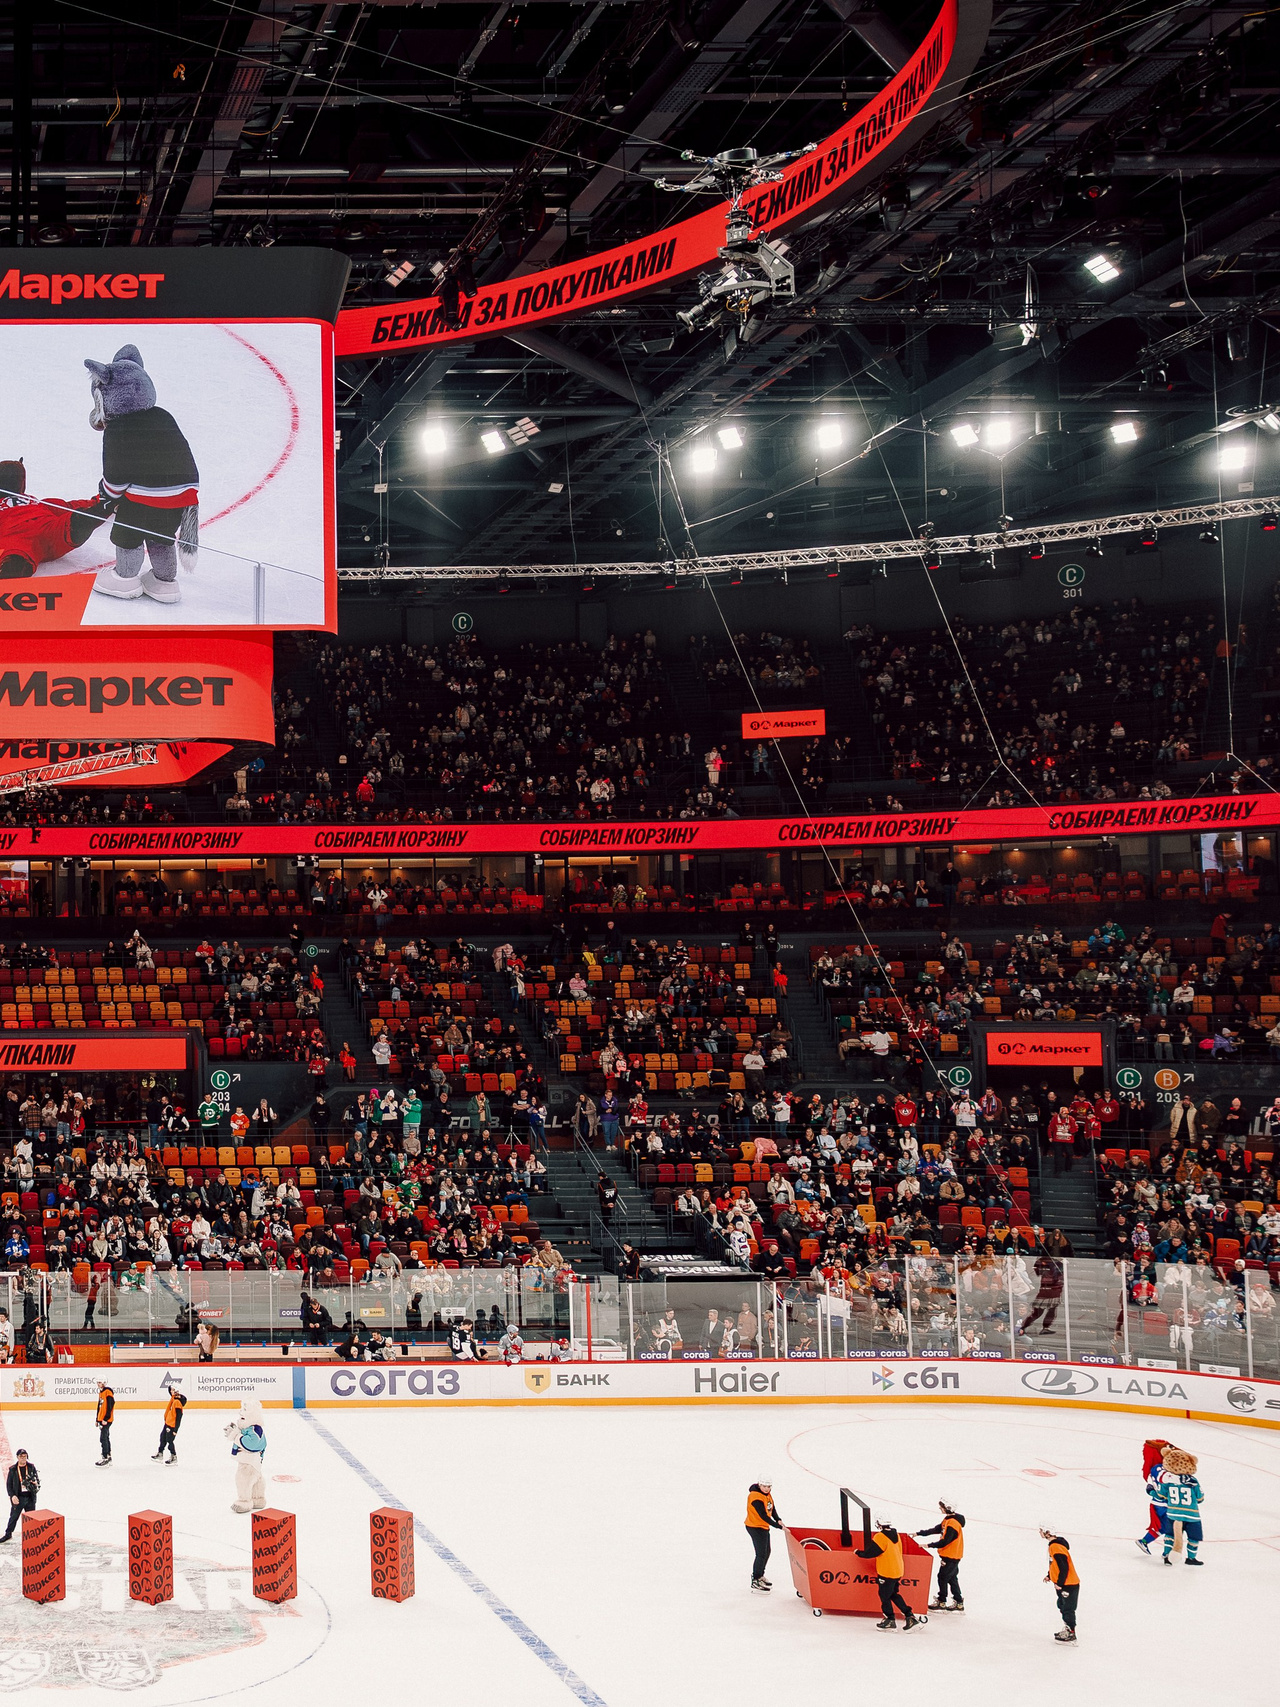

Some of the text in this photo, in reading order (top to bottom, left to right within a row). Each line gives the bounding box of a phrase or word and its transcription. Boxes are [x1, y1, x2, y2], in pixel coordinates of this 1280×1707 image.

[824, 134, 852, 186] ЗА
[852, 25, 945, 164] ПОКУПКАМИ
[474, 295, 511, 327] ЗА
[510, 237, 677, 320] ПОКУПКАМИ
[1063, 588, 1082, 598] 301
[772, 720, 817, 729] Маркет
[1048, 800, 1259, 830] СОБИРАЕМ КОРЗИНУ
[314, 829, 468, 848] СОБИРАЕМ КОРЗИНУ
[539, 826, 699, 846] СОБИРАЕМ КОРЗИНУ
[778, 816, 960, 842] СОБИРАЕМ КОРЗИНУ
[89, 831, 243, 850] СОБИРАЕМ КОРЗИНУ
[1028, 1044, 1091, 1055] Маркет
[211, 1092, 231, 1102] 203
[1156, 1092, 1180, 1103] 203
[197, 1376, 277, 1386] Центр спортивных
[197, 1384, 255, 1393] мероприятий
[557, 1373, 610, 1386] БАНК
[693, 1365, 780, 1393] Haier
[903, 1367, 960, 1389] сбп
[1107, 1377, 1189, 1400] LADA
[1168, 1486, 1193, 1506] 93
[22, 1530, 60, 1559] Маркет
[253, 1527, 294, 1560] Маркет
[22, 1549, 60, 1577] Маркет
[253, 1546, 294, 1578] Маркет
[22, 1566, 60, 1595] Маркет
[253, 1564, 294, 1595] Маркет
